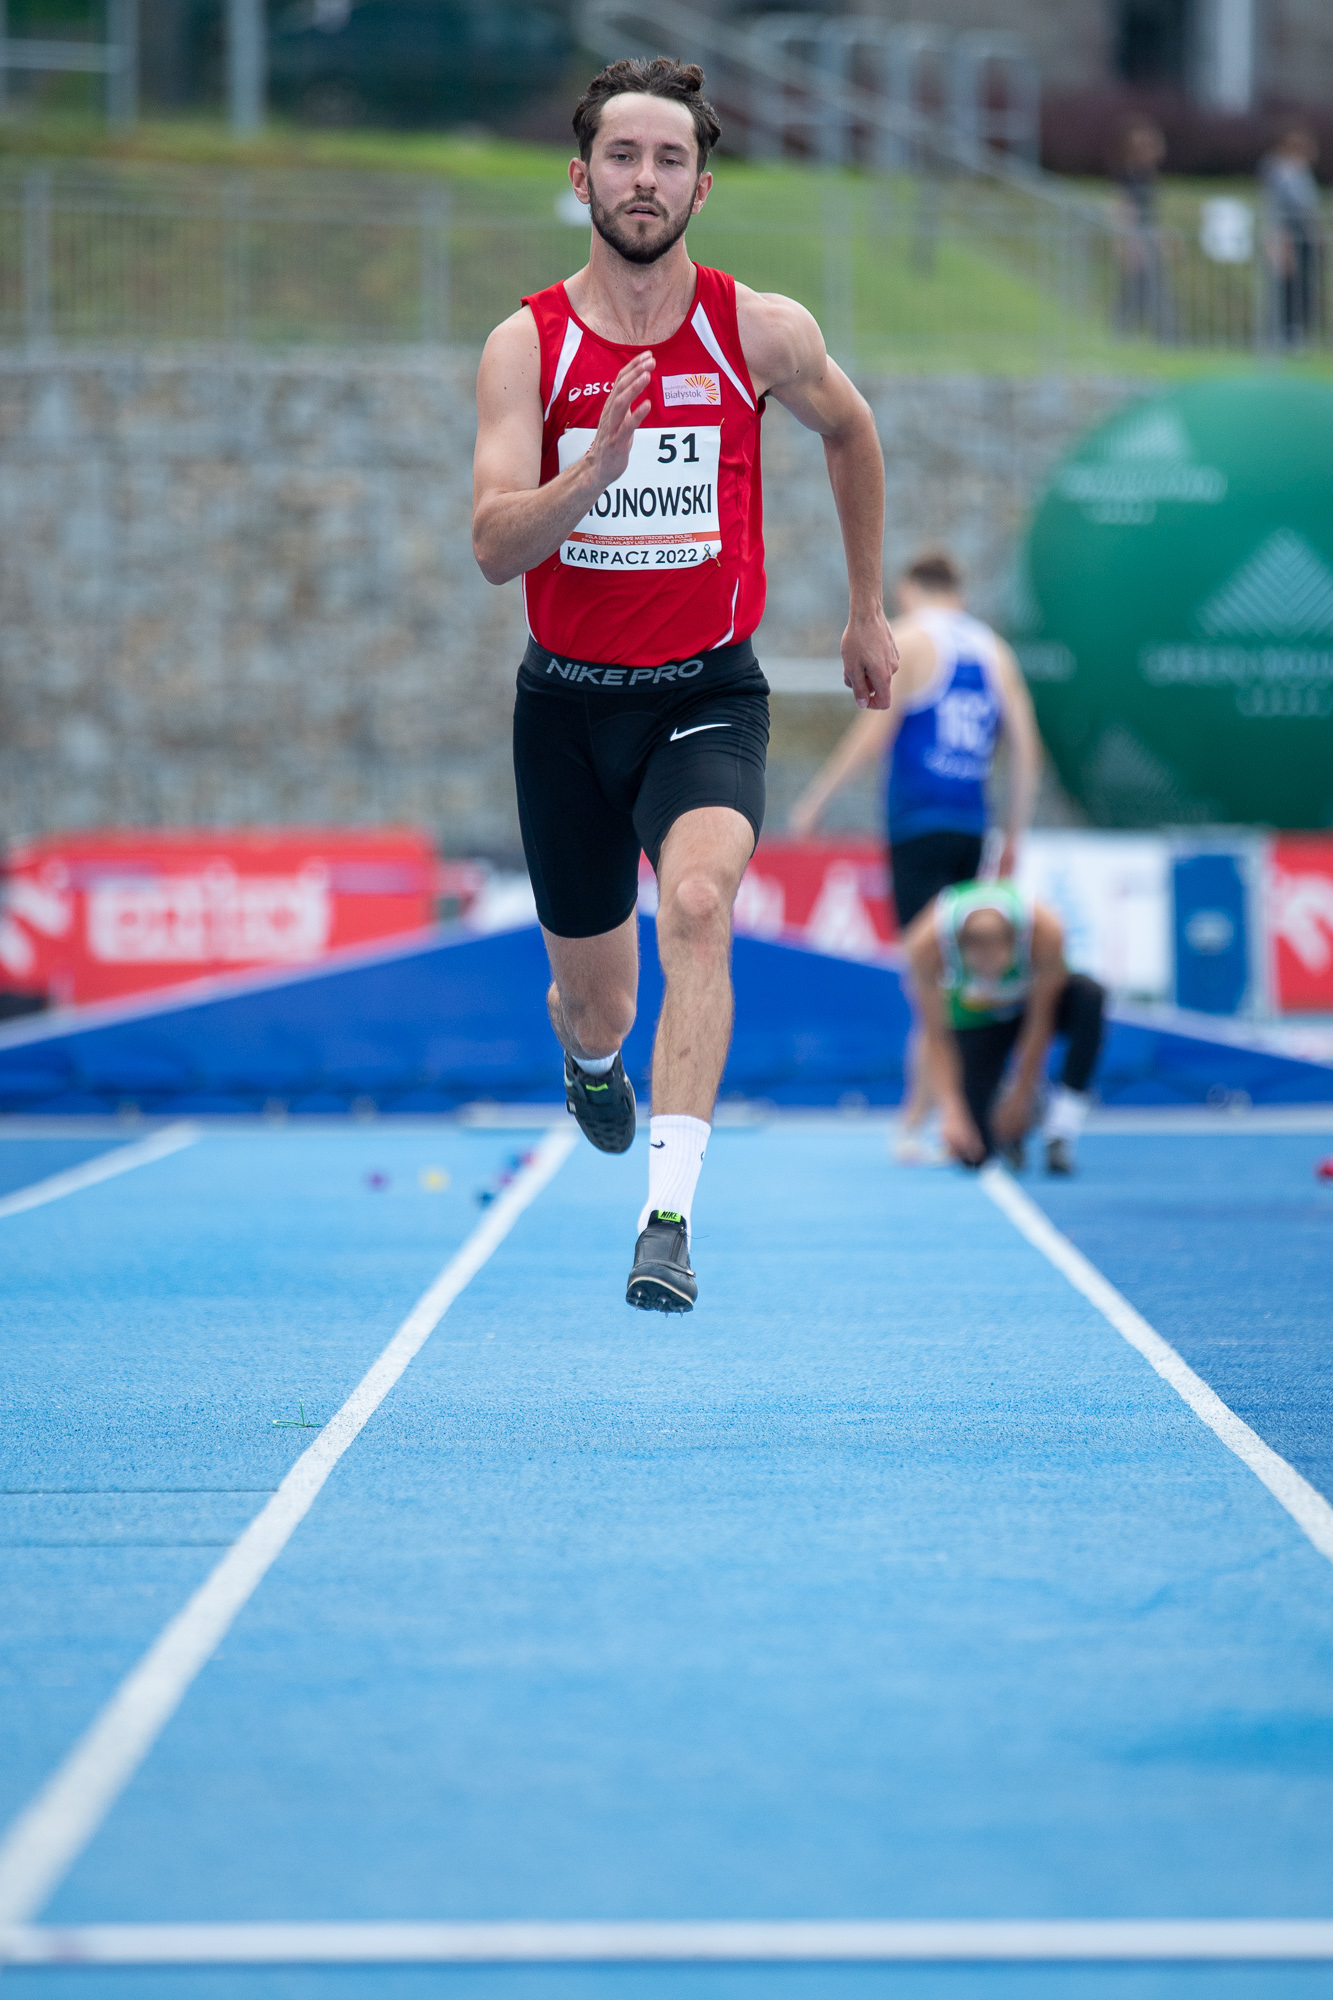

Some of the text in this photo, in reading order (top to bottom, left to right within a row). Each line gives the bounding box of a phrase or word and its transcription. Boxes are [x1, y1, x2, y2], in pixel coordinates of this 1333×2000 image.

[665, 389, 702, 399] Białystok
[657, 432, 700, 464] 51
[589, 484, 711, 518] OJNOWSKI
[567, 546, 698, 565] KARPACZ 2022
[546, 658, 704, 686] NIKE PRO
[658, 1211, 677, 1220] NIKE
